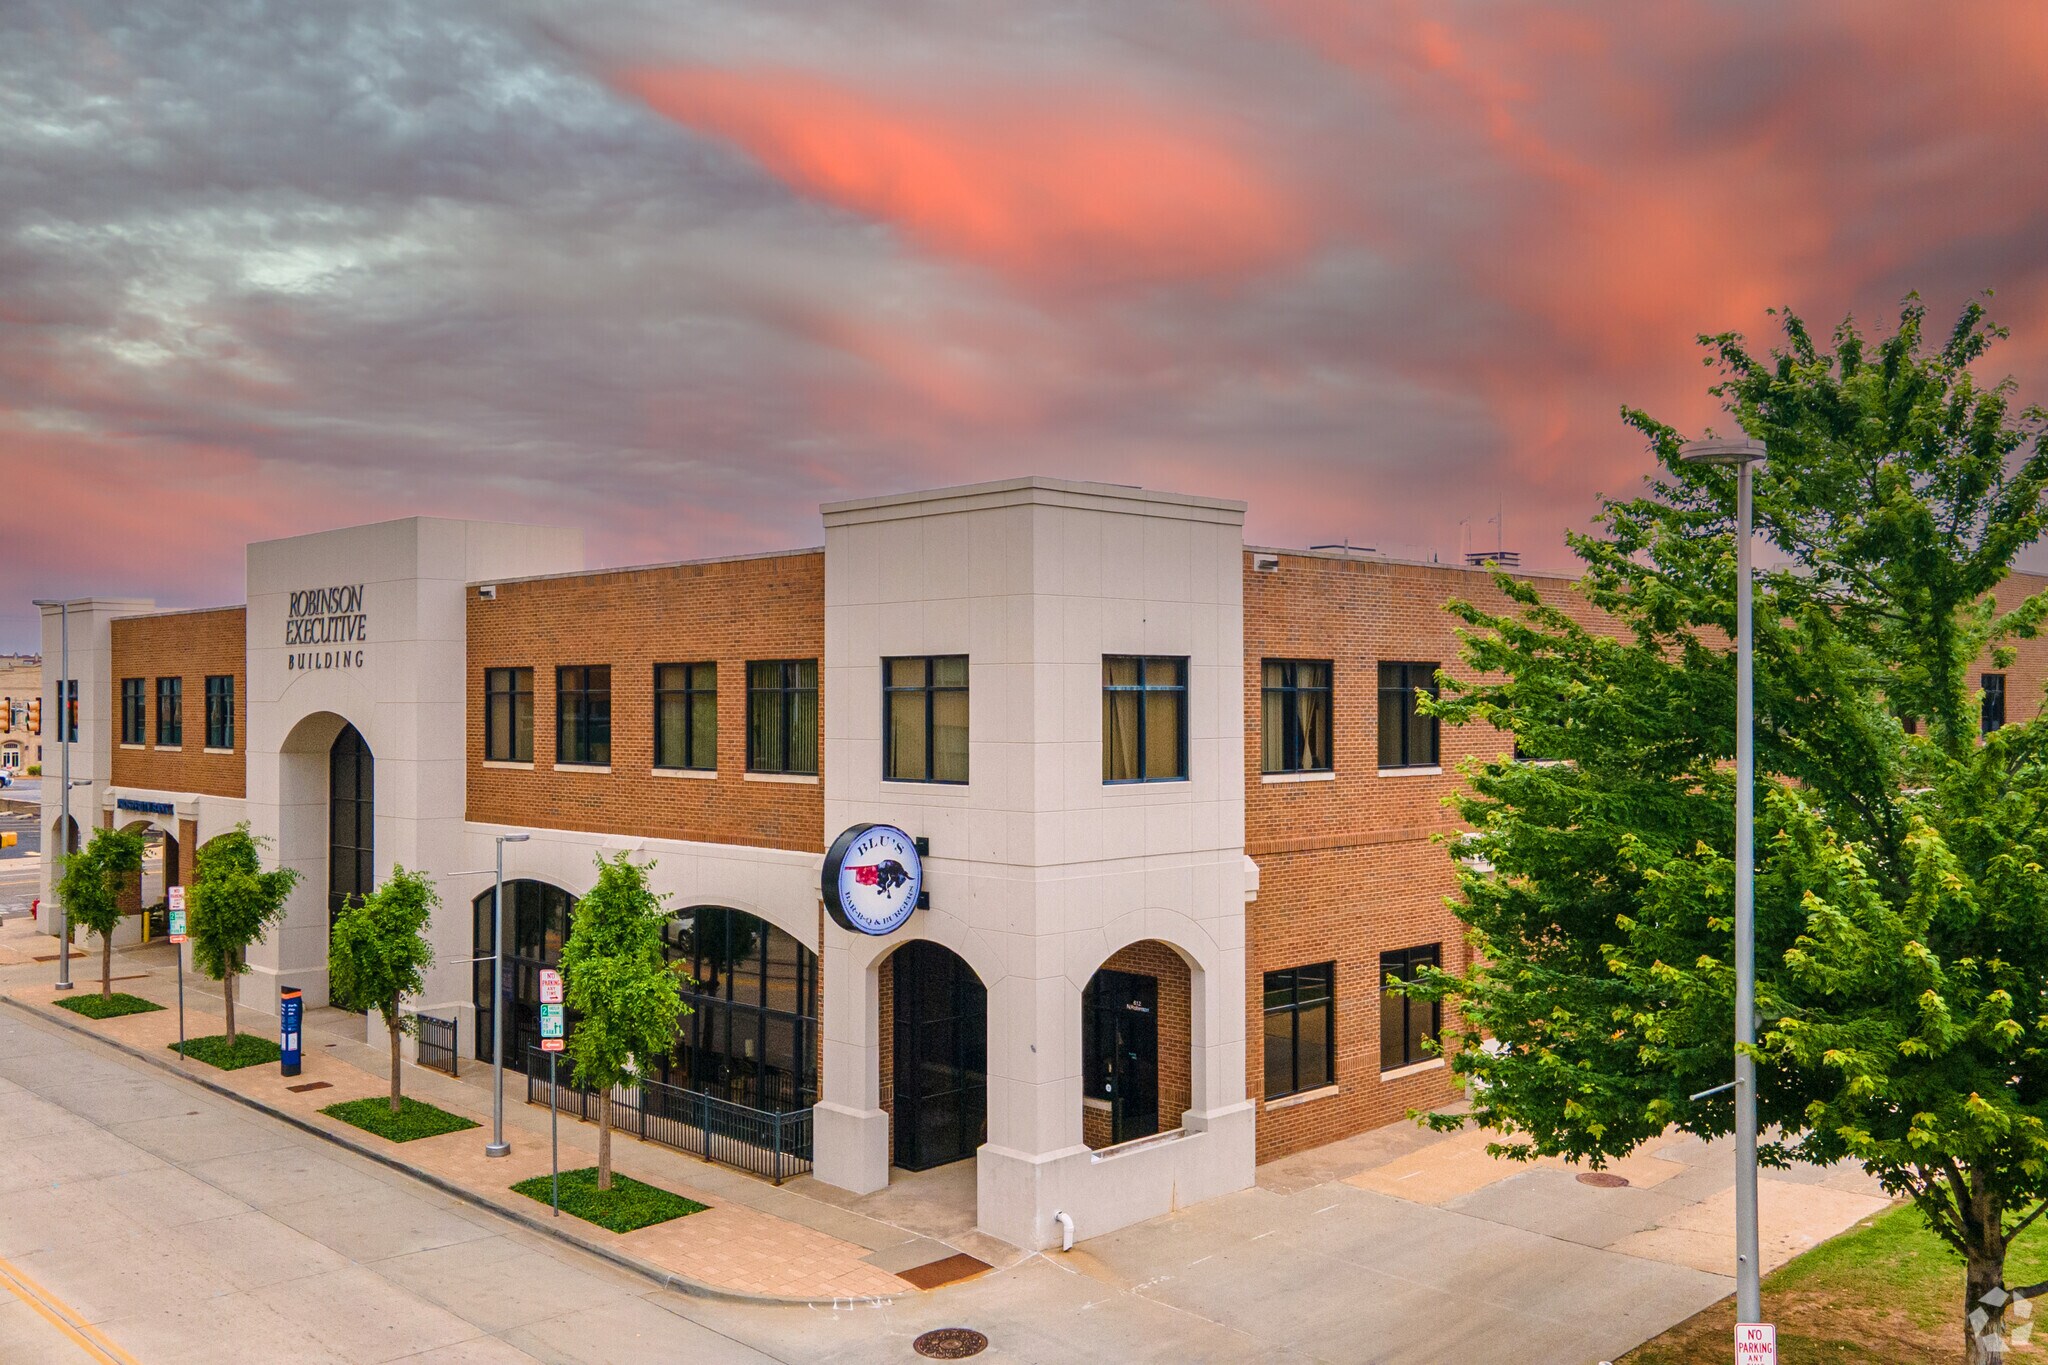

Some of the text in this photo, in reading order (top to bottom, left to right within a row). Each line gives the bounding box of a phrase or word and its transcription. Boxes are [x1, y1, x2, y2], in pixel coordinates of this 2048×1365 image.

[289, 585, 364, 618] ROBINSON
[285, 614, 367, 645] EXECUTIVE
[288, 650, 364, 670] BUILDING
[857, 835, 905, 856] BLU'S
[844, 891, 873, 926] BAR-B-Q
[882, 885, 914, 925] BURGERS
[1748, 1329, 1762, 1340] NO
[1739, 1342, 1772, 1353] PARKING
